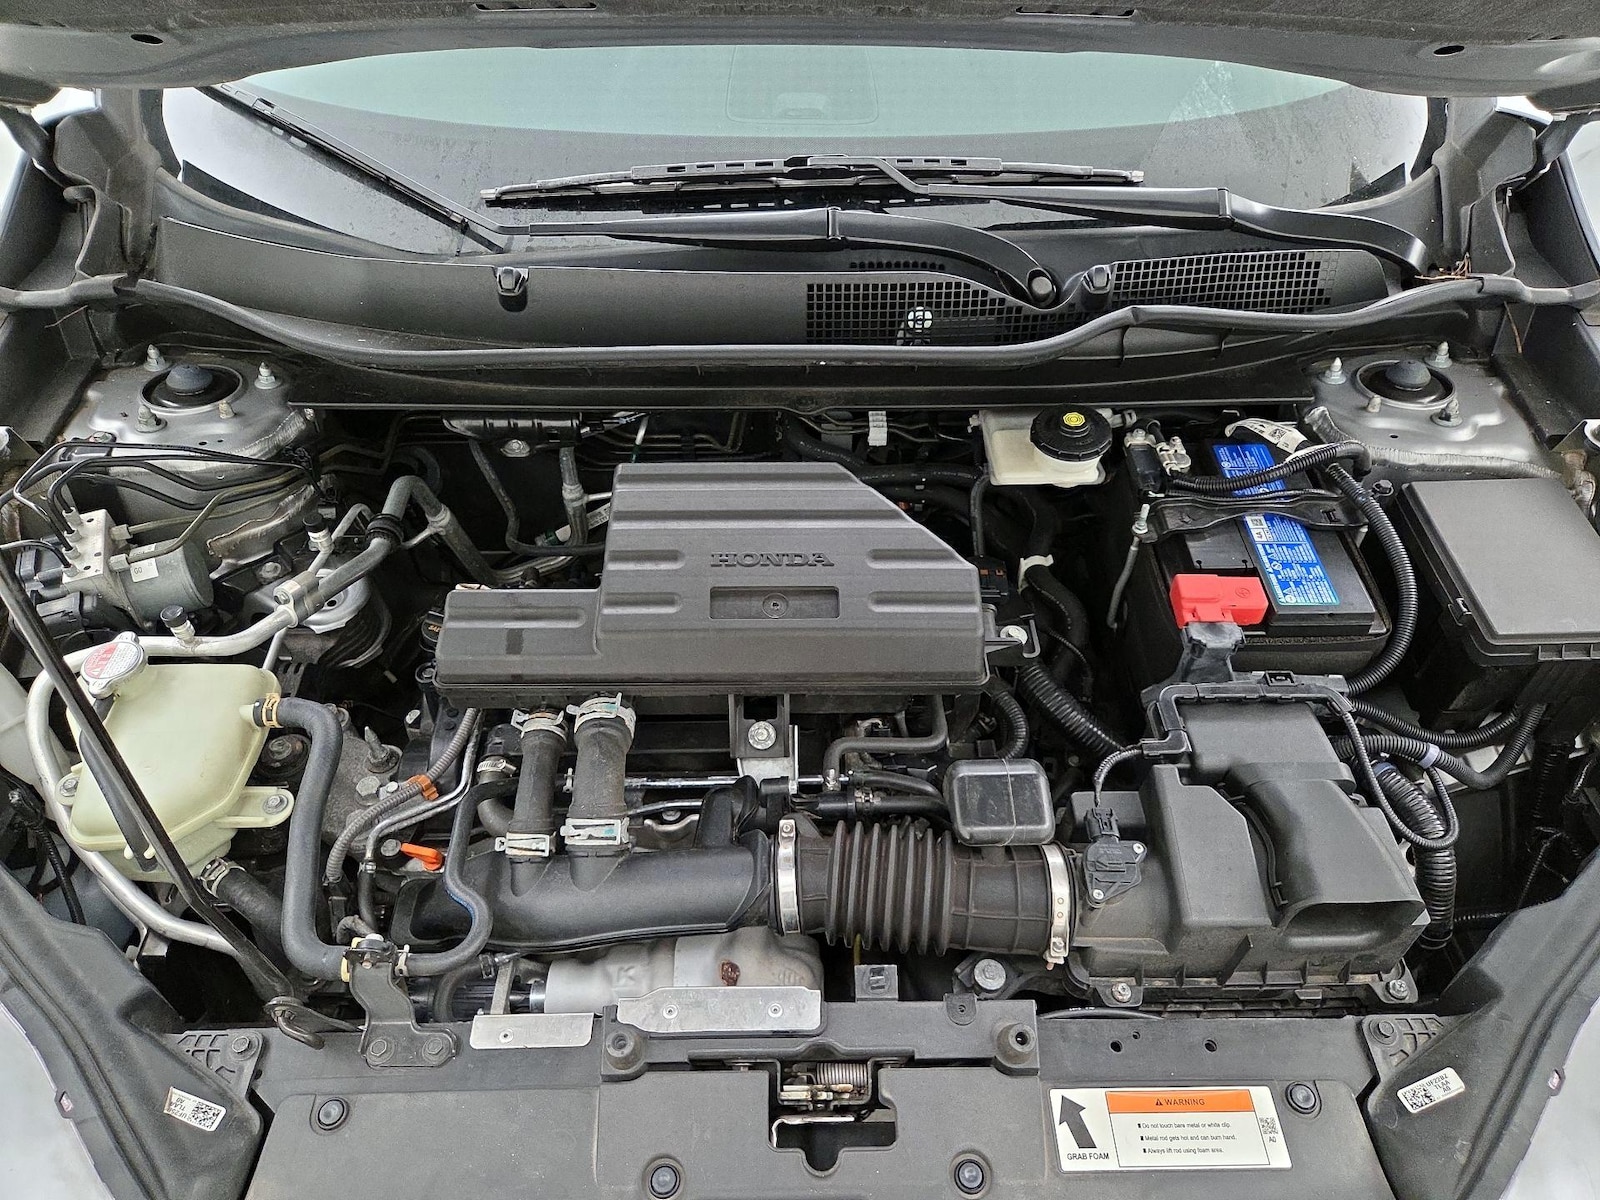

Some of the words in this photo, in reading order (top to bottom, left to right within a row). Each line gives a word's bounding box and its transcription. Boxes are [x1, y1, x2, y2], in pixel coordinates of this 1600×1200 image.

[710, 552, 835, 567] HONDA
[1165, 1098, 1205, 1106] WARNING
[1089, 1152, 1109, 1160] FOAM
